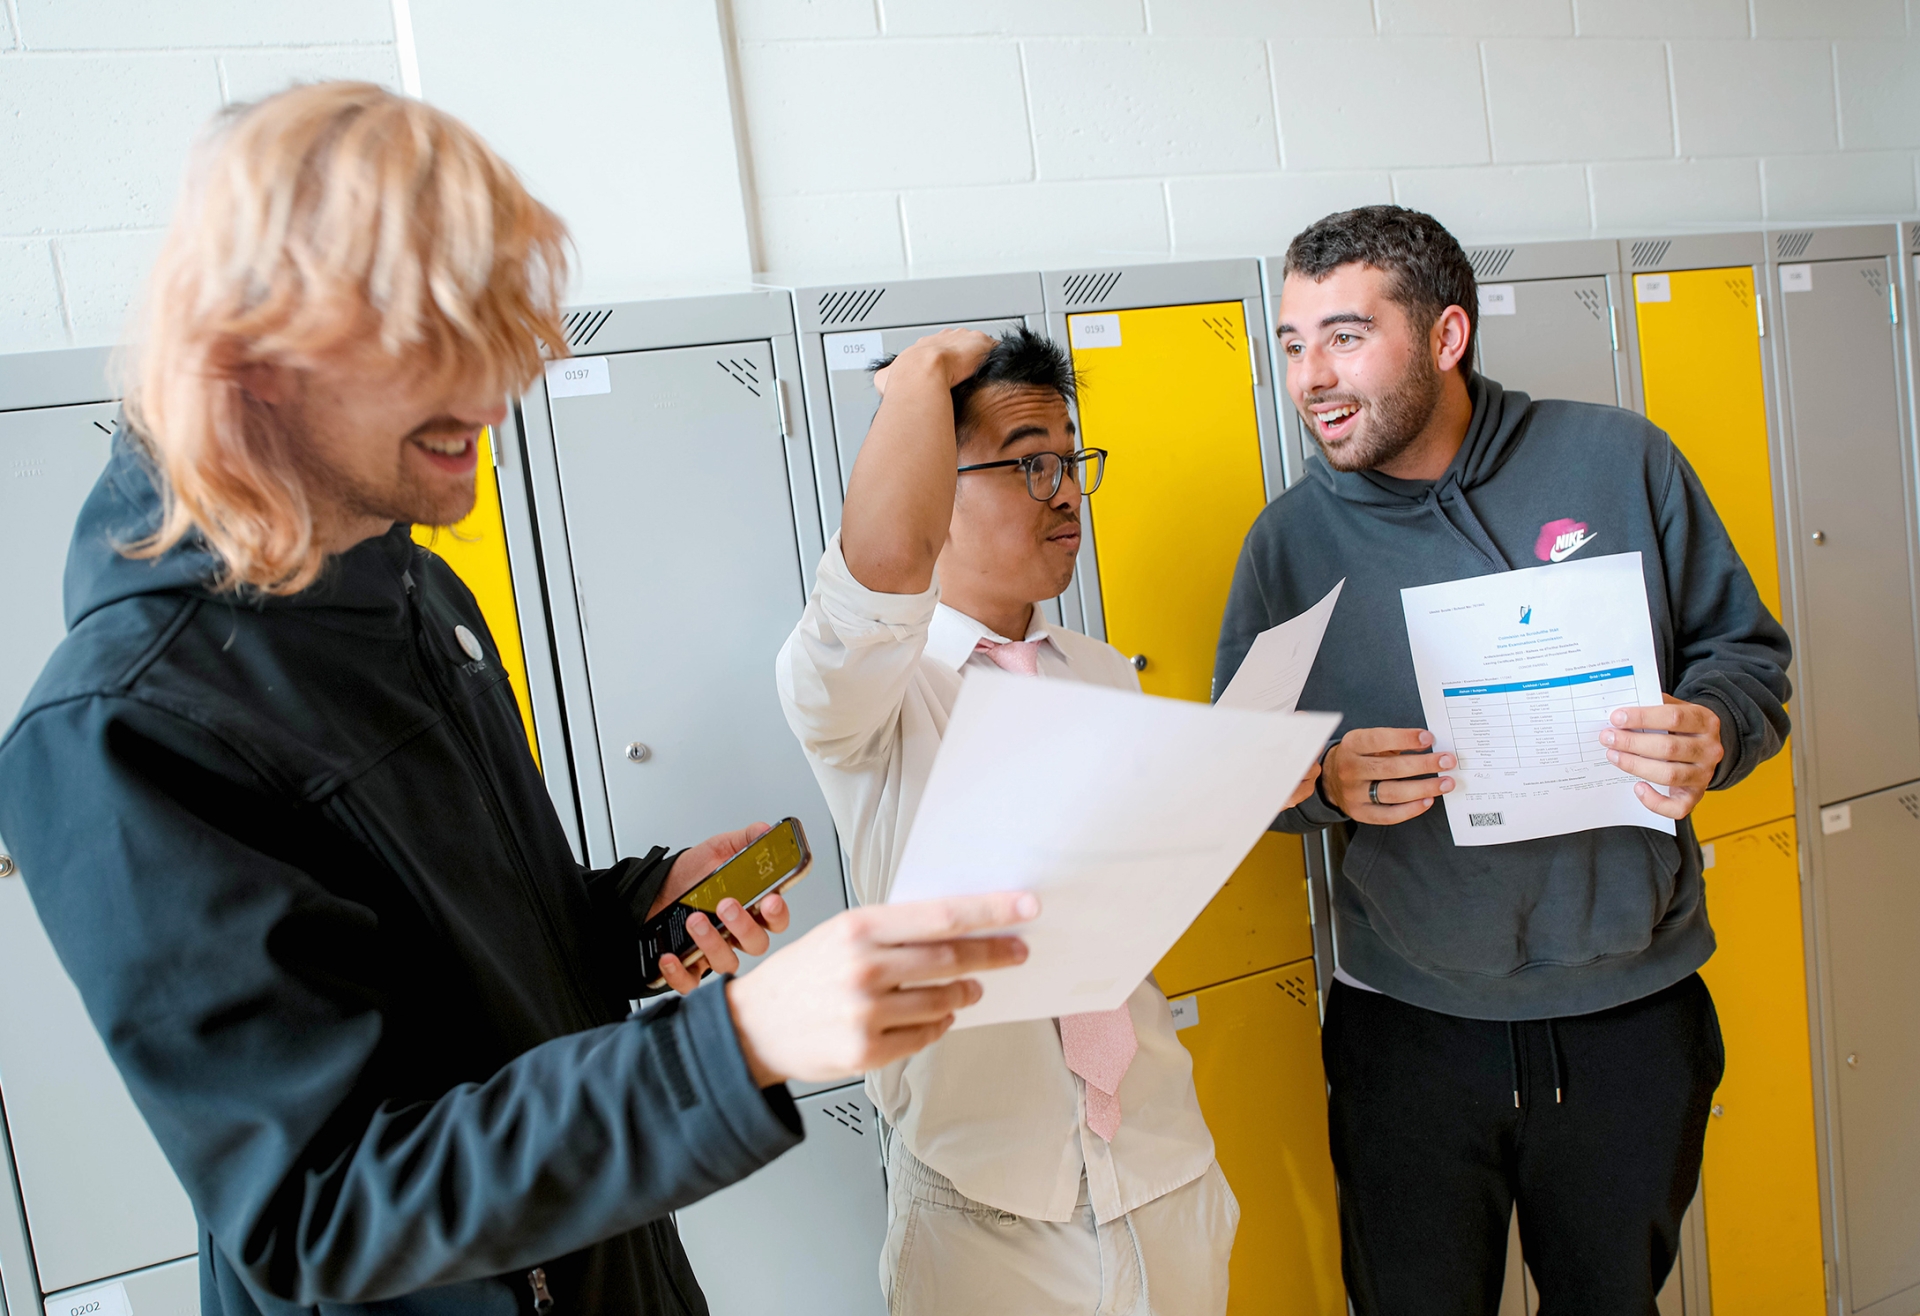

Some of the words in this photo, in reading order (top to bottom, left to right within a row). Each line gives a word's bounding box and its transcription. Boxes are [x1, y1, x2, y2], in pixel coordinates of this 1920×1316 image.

[1084, 325, 1105, 334] 0193
[843, 344, 866, 354] 0195
[564, 369, 589, 381] 0197
[1554, 528, 1585, 551] NIKE
[70, 1301, 101, 1316] 0202
